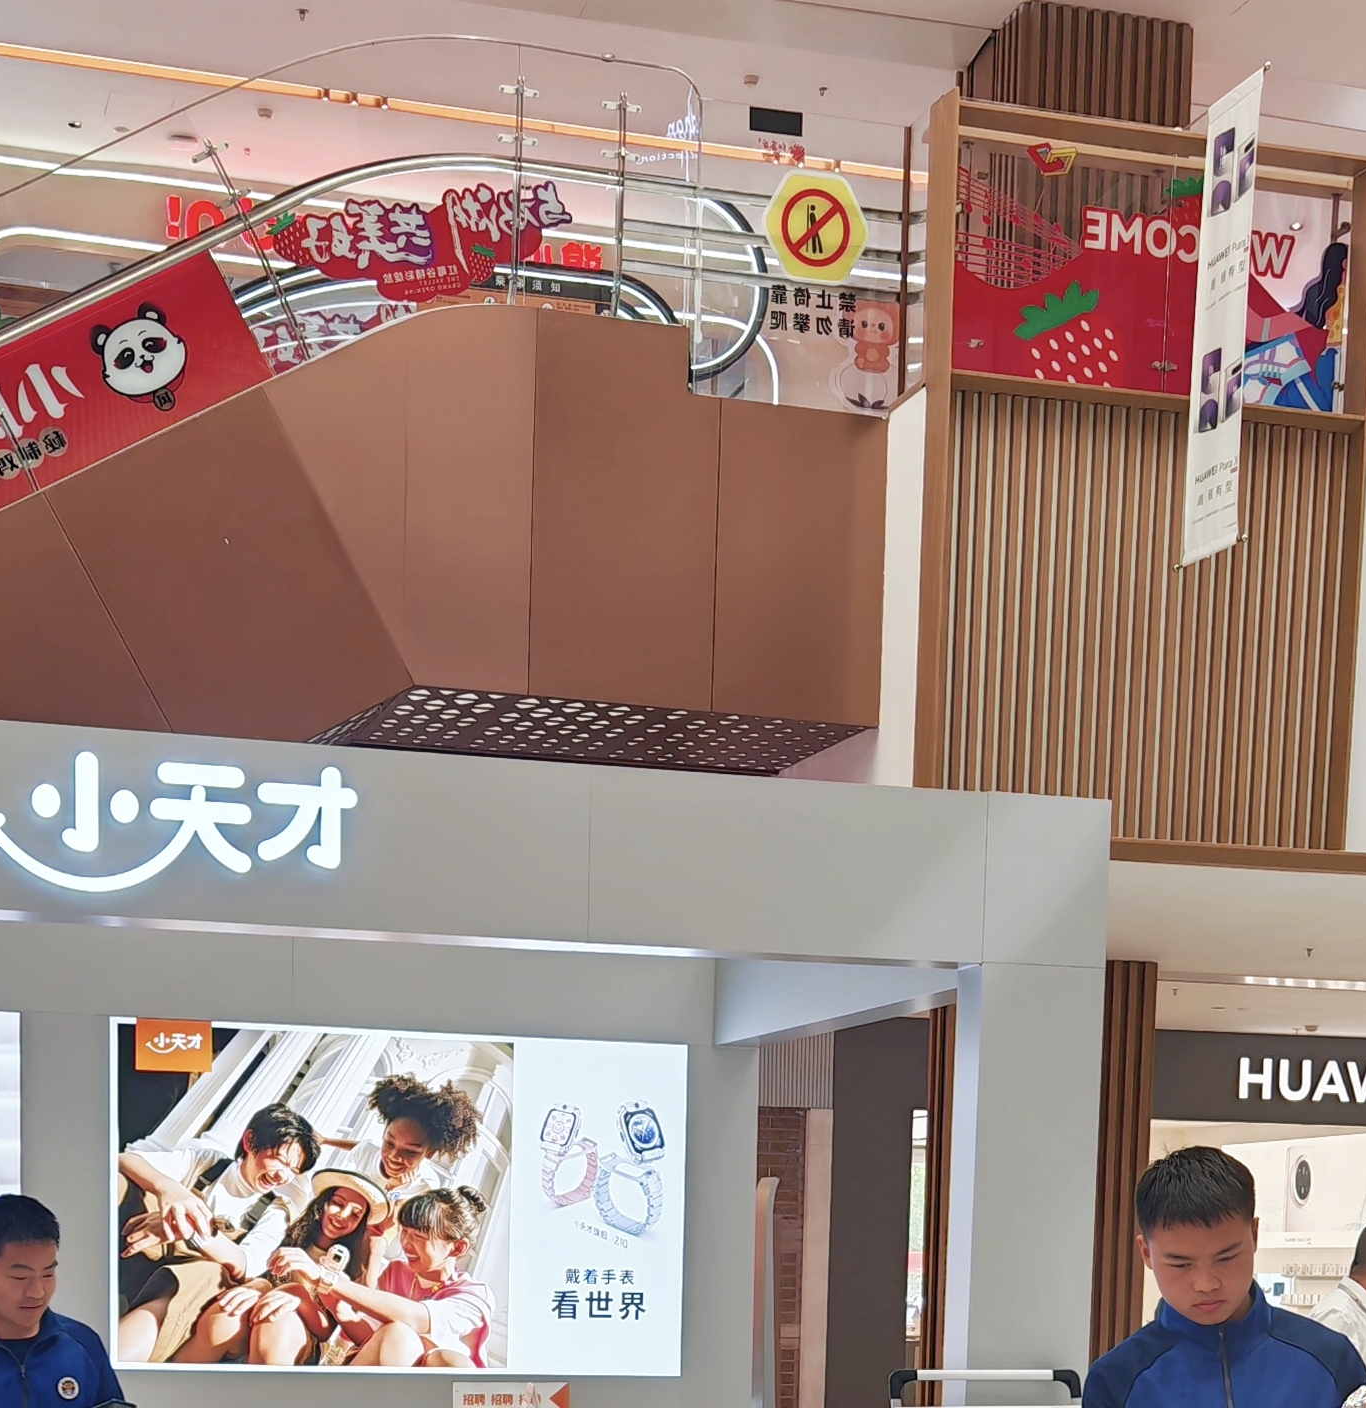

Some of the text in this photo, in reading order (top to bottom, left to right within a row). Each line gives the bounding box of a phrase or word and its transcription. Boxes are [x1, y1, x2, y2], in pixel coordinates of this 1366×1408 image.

[1207, 245, 1231, 271] HUAWEI
[1194, 463, 1218, 486] HUAWEI
[145, 1032, 203, 1054] 小天才
[565, 1268, 634, 1285] 戴着手表
[552, 1290, 646, 1320] 看世界
[462, 1393, 486, 1406] 招聘
[490, 1393, 514, 1406] 招聘
